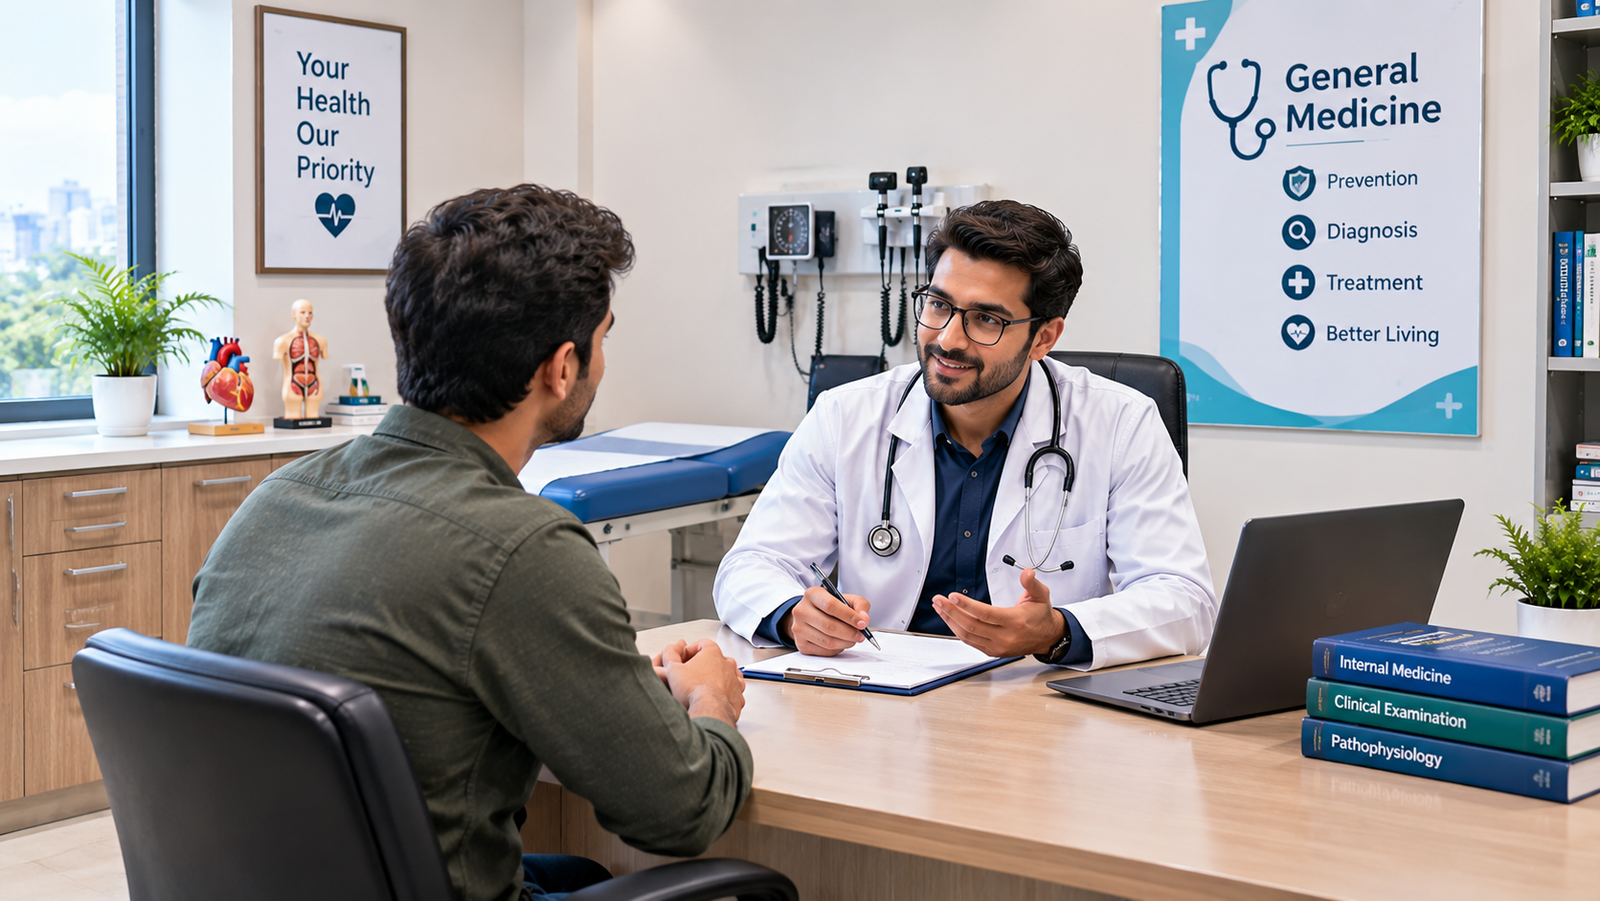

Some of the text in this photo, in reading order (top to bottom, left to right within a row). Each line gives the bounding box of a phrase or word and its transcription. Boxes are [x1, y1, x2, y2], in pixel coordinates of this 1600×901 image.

[297, 51, 349, 80] Your
[1286, 52, 1419, 93] General
[297, 86, 371, 116] Health
[1286, 95, 1442, 132] Medicine
[297, 121, 339, 146] Our
[297, 155, 375, 188] Priority
[1327, 170, 1418, 190] Prevention
[1327, 221, 1418, 244] Diagnosis
[1326, 274, 1423, 291] Treatment
[1326, 325, 1439, 347] Better Living
[1340, 654, 1389, 675] Internal
[1392, 663, 1452, 685] Medicine
[1334, 694, 1381, 715] Clinical
[1384, 702, 1467, 729] Examination
[1331, 733, 1443, 769] Pathophysiology
